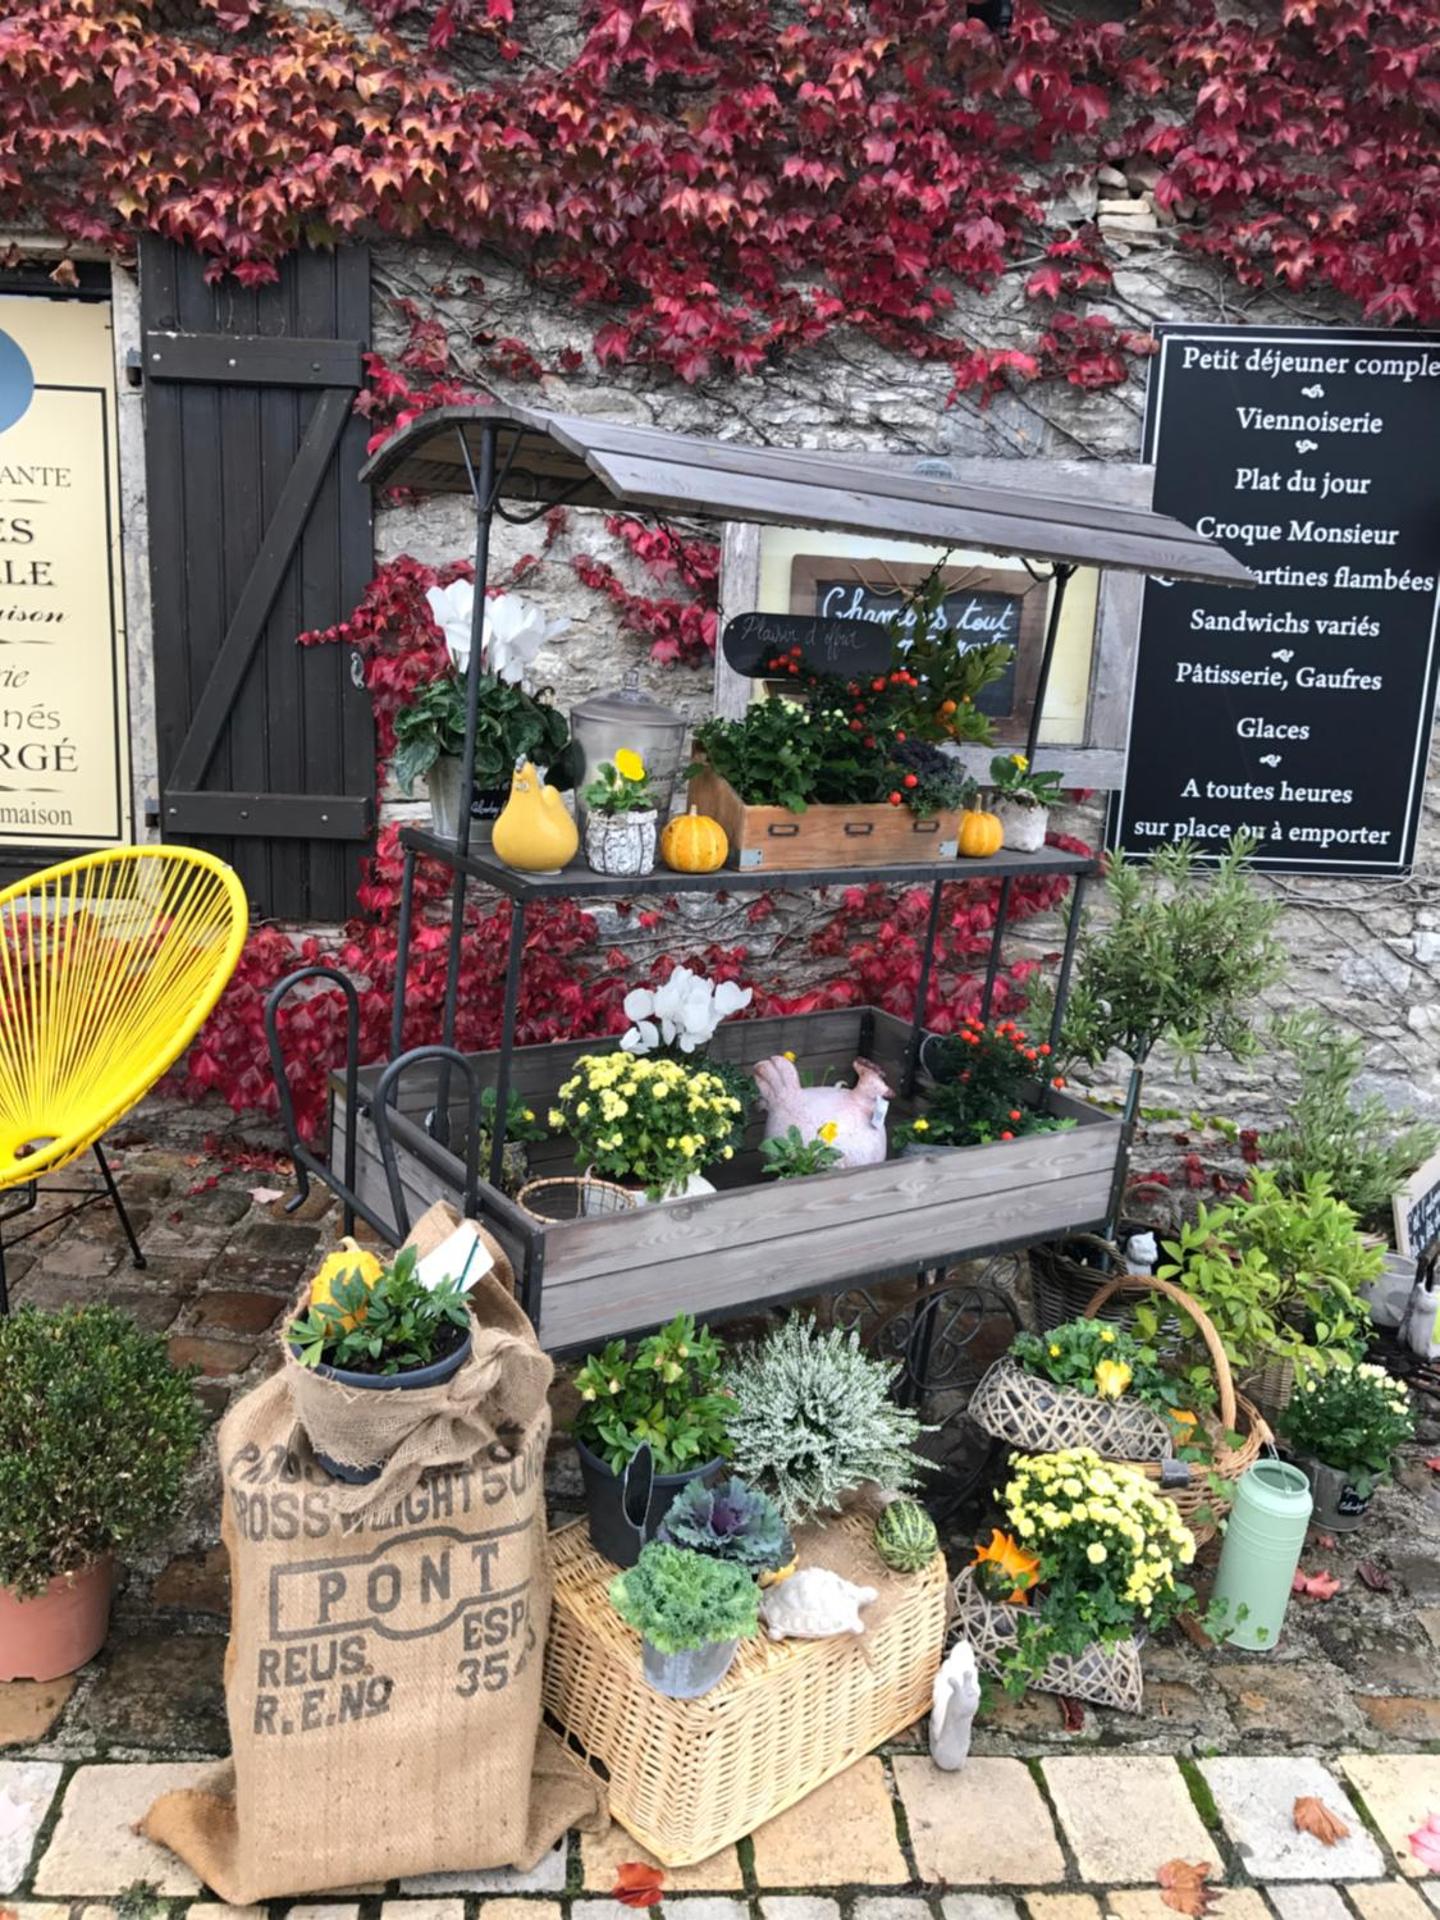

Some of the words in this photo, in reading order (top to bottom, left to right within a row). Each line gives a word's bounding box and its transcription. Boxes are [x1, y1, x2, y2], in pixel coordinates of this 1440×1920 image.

[1182, 347, 1239, 370] Petit
[1245, 348, 1349, 378] déjeuner
[1236, 407, 1383, 433] Viennoiserie
[1235, 468, 1281, 490] Plat
[1287, 470, 1316, 492] du
[1321, 472, 1371, 499] jour
[0, 518, 34, 544] S
[1196, 517, 1282, 547] Croque
[1287, 520, 1399, 545] Monsieur
[0, 560, 54, 586] LE
[1334, 566, 1434, 591] flambées
[0, 606, 63, 622] ison
[956, 599, 1014, 631] tout
[1190, 609, 1309, 633] Sandwichs
[1315, 616, 1380, 636] variés
[1176, 660, 1289, 690] Pâtisserie,
[1296, 667, 1382, 690] Gaufres
[1237, 718, 1309, 739] Glaces
[1181, 779, 1200, 797] A
[1207, 782, 1274, 800] toutes
[1280, 781, 1352, 803] heures
[0, 802, 72, 825] maison
[1134, 822, 1169, 835] sur
[1173, 817, 1232, 842] place
[1238, 824, 1266, 841] ou
[1271, 821, 1282, 840] à
[1289, 827, 1390, 848] emporter
[317, 1542, 499, 1624] PONT
